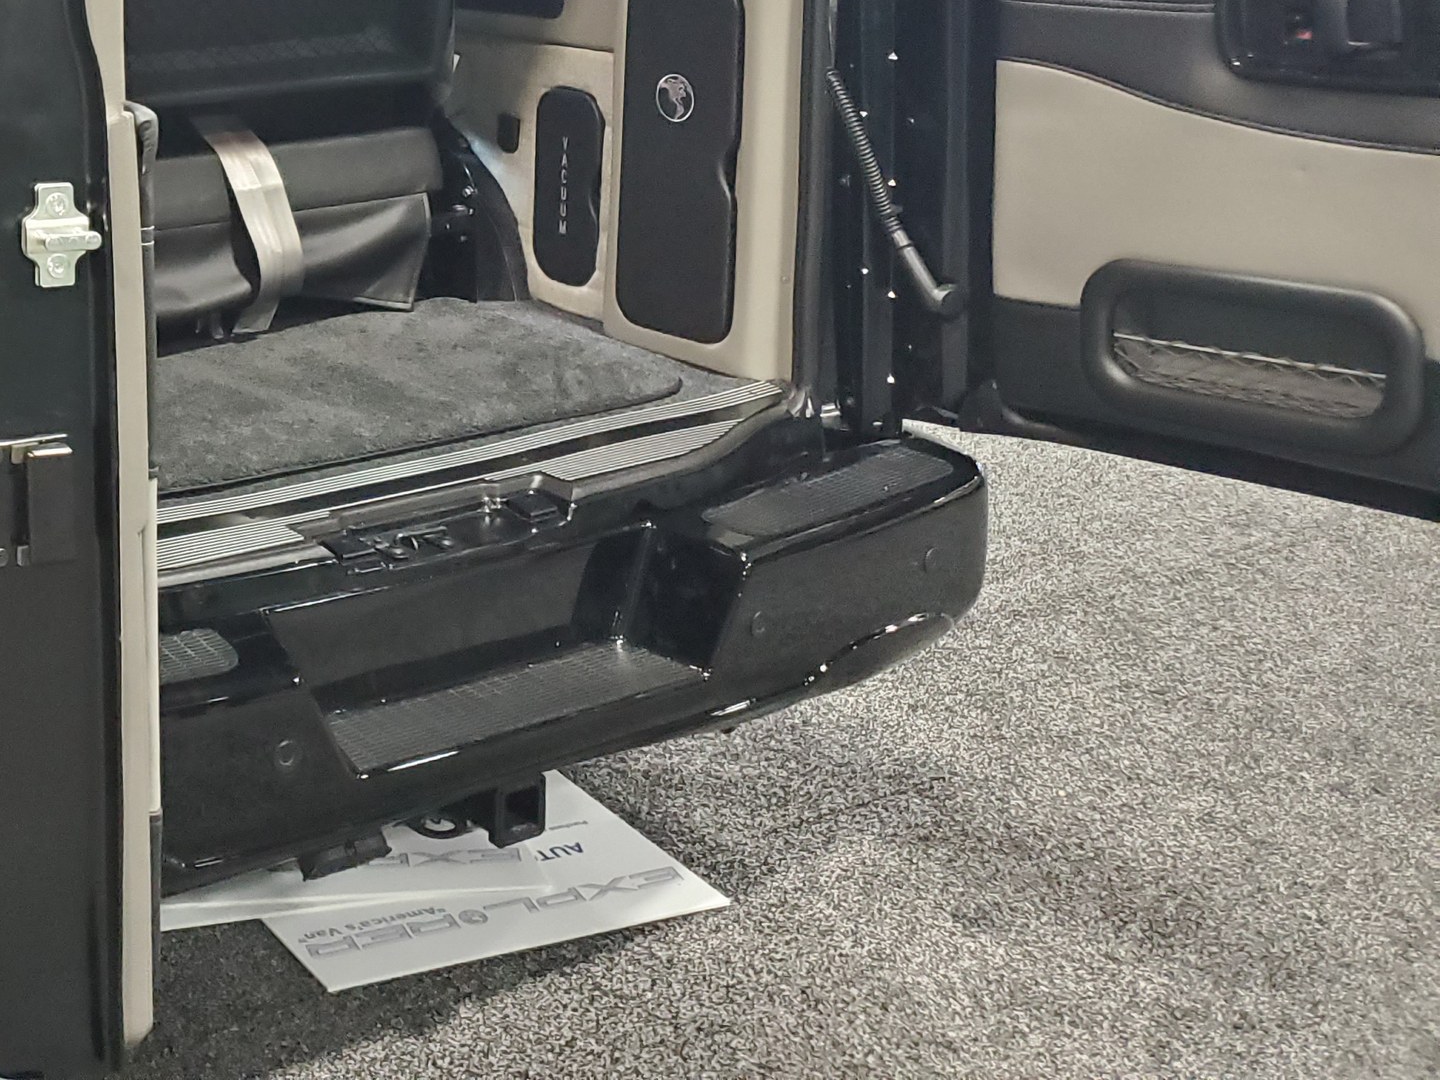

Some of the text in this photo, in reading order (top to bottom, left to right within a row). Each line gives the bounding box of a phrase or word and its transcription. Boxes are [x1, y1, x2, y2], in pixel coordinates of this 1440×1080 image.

[557, 136, 569, 235] VACUUM
[535, 842, 584, 862] AUT
[306, 866, 685, 958] EXPLORER
